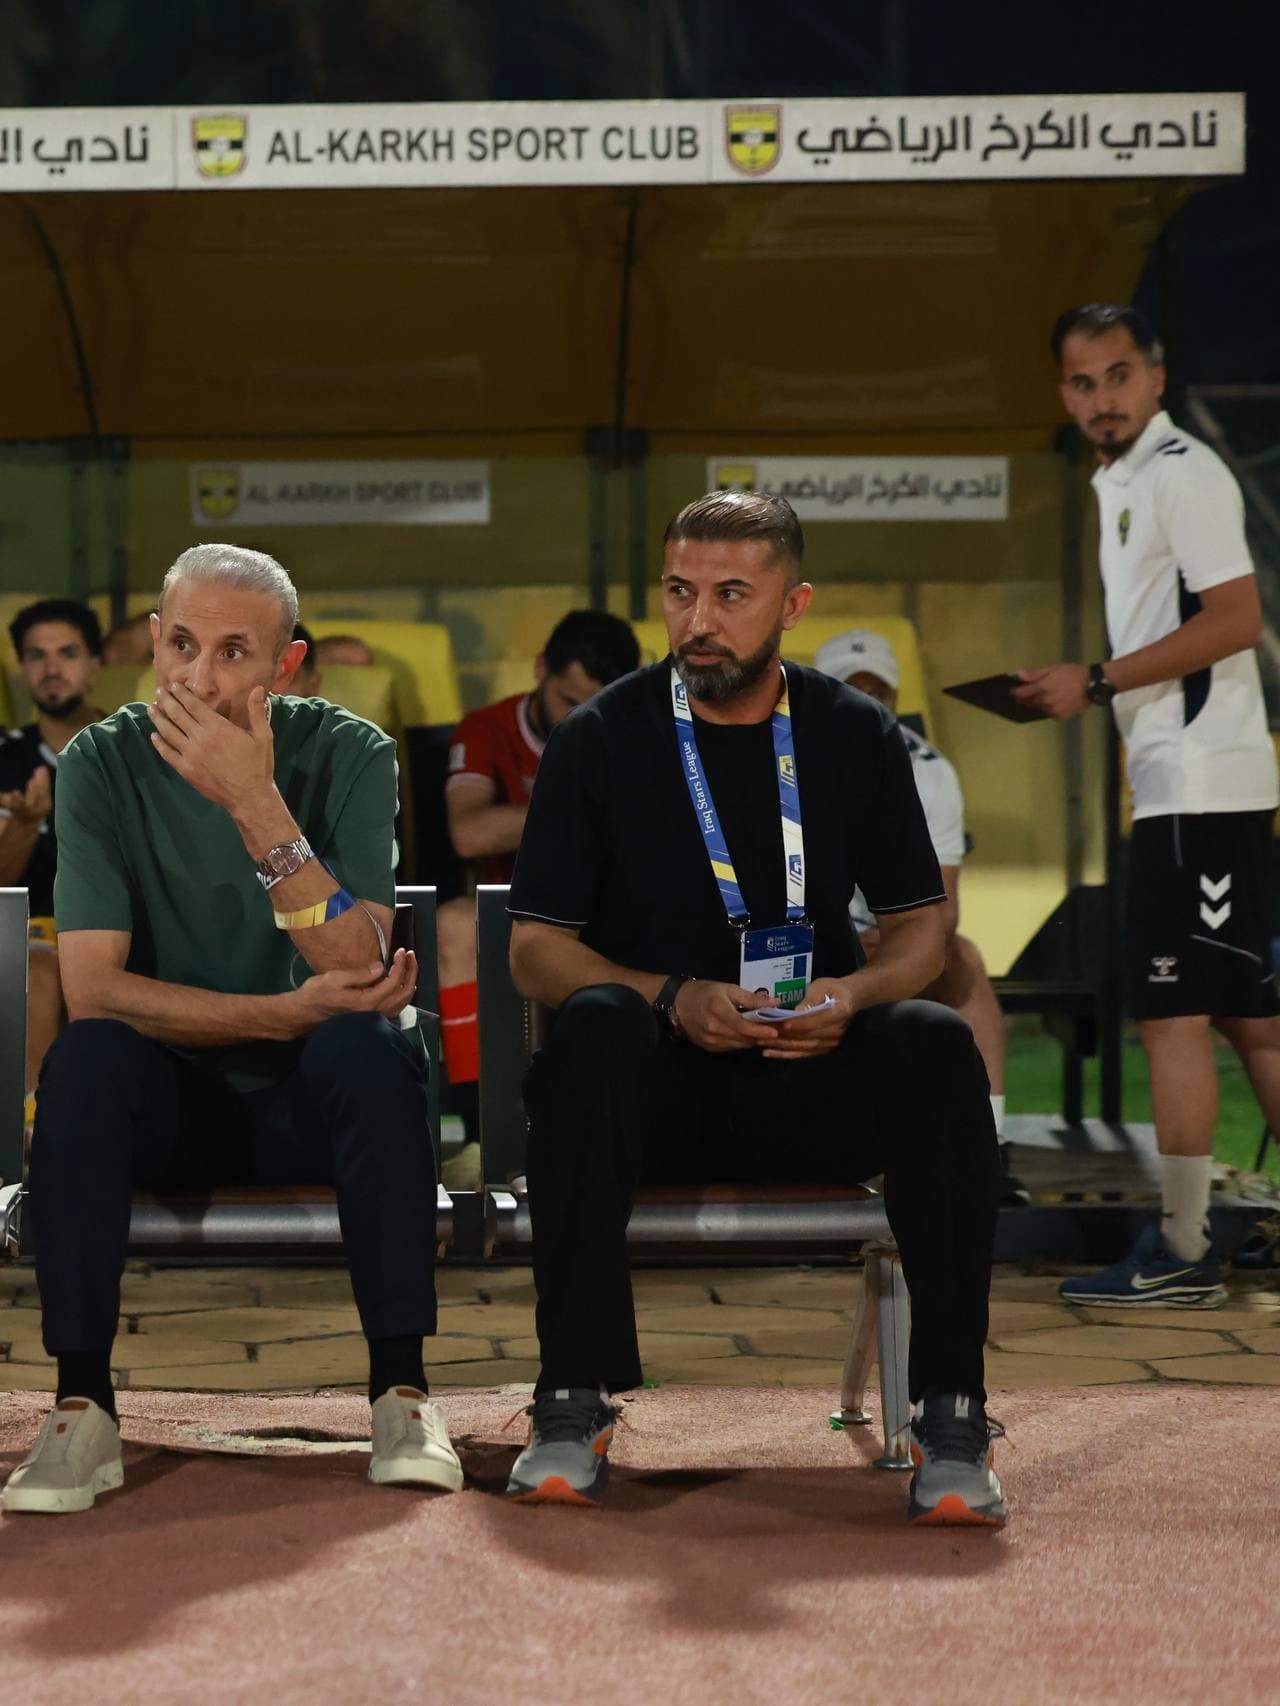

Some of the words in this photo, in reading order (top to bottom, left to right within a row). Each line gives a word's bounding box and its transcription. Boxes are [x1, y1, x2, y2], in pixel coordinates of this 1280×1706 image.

[32, 125, 150, 176] نادي
[266, 128, 454, 165] AL-KARKH
[467, 126, 591, 162] SPORT
[601, 125, 699, 161] CLUB
[795, 114, 972, 166] الرياضي
[981, 109, 1089, 162] الكرخ
[1099, 109, 1218, 161] نادي
[246, 482, 350, 503] AL-KARKH
[354, 481, 421, 502] SPORT
[427, 480, 482, 502] CLUB
[866, 471, 931, 506] الكرخ
[932, 472, 1003, 506] نادي
[683, 740, 699, 781] League
[694, 781, 708, 811] Stars
[702, 809, 716, 834] Iraq
[777, 988, 804, 1004] TEAM
